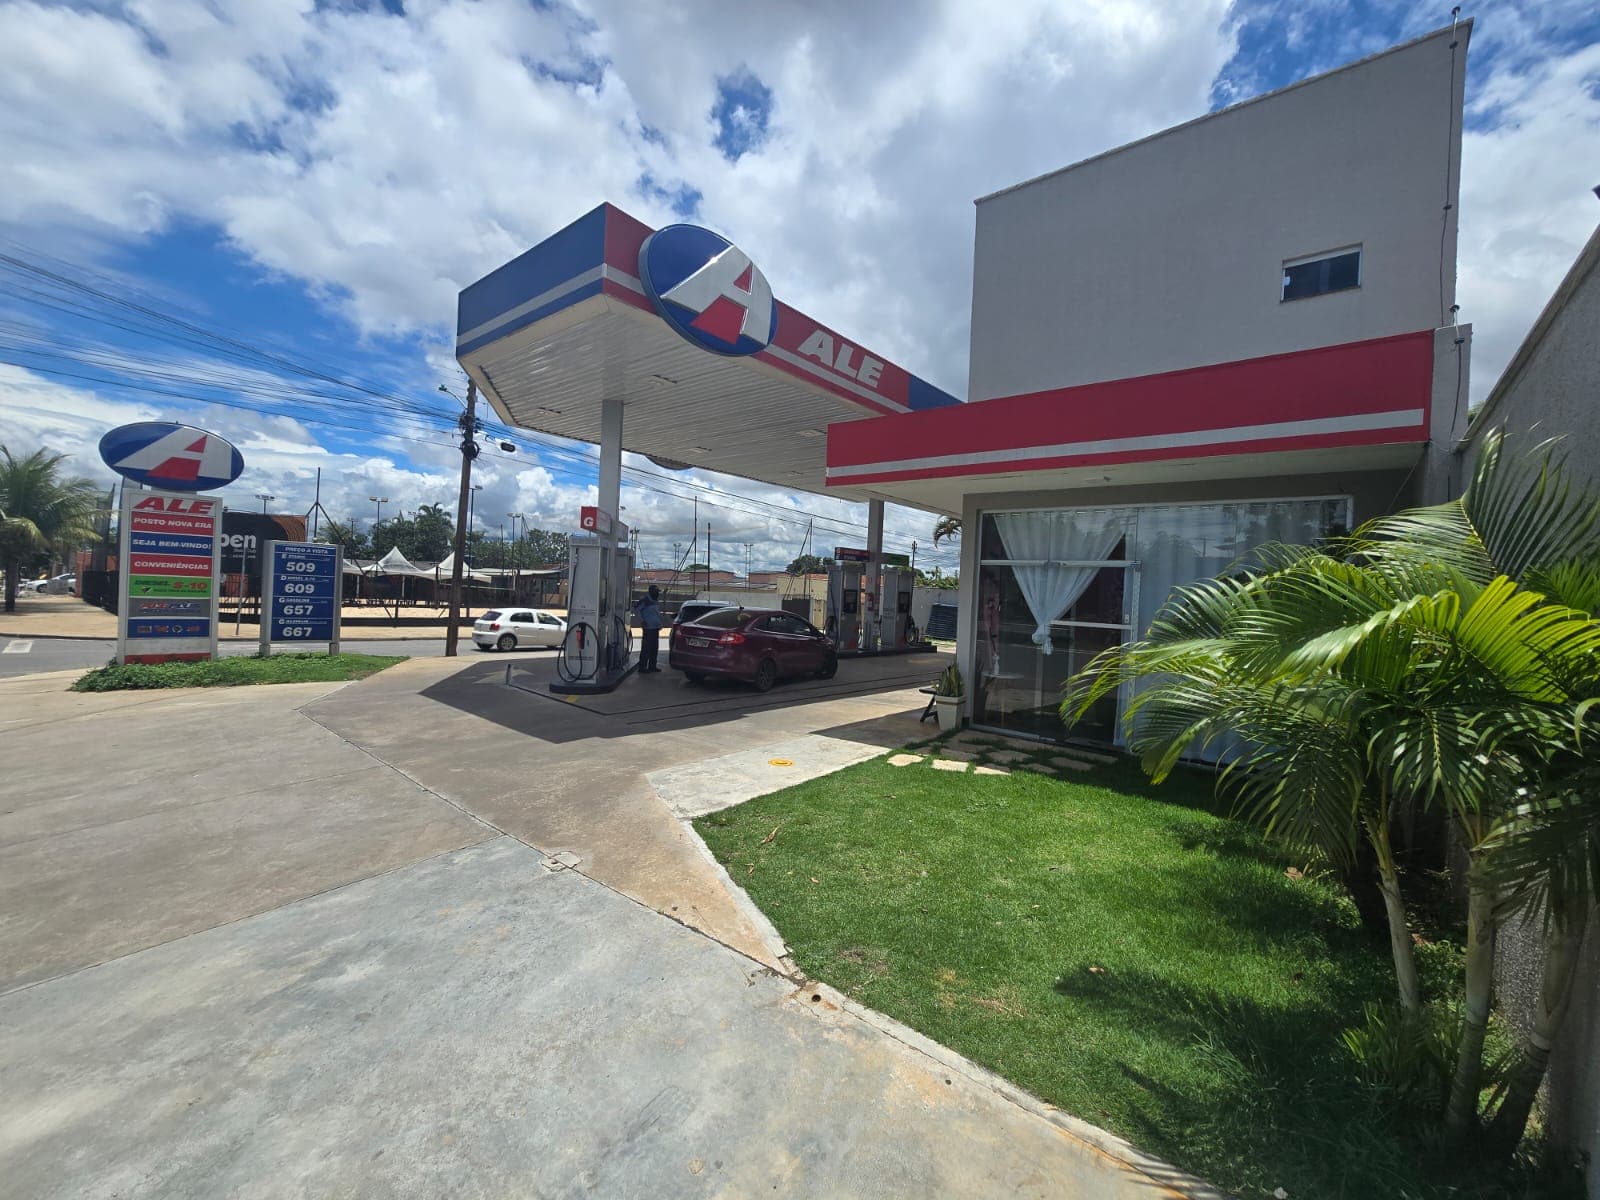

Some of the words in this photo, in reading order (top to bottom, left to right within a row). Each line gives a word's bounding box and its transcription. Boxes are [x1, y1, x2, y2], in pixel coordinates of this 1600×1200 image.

[798, 330, 885, 388] ALE
[133, 496, 214, 514] ALE
[133, 517, 166, 526] POSTO
[167, 519, 193, 527] NOVA
[584, 517, 594, 527] G
[132, 538, 157, 546] SEJA
[158, 540, 212, 550] BEM-VINDO!
[285, 561, 316, 573] 509
[284, 583, 315, 594] 609
[283, 605, 314, 616] 657
[282, 626, 313, 638] 667
